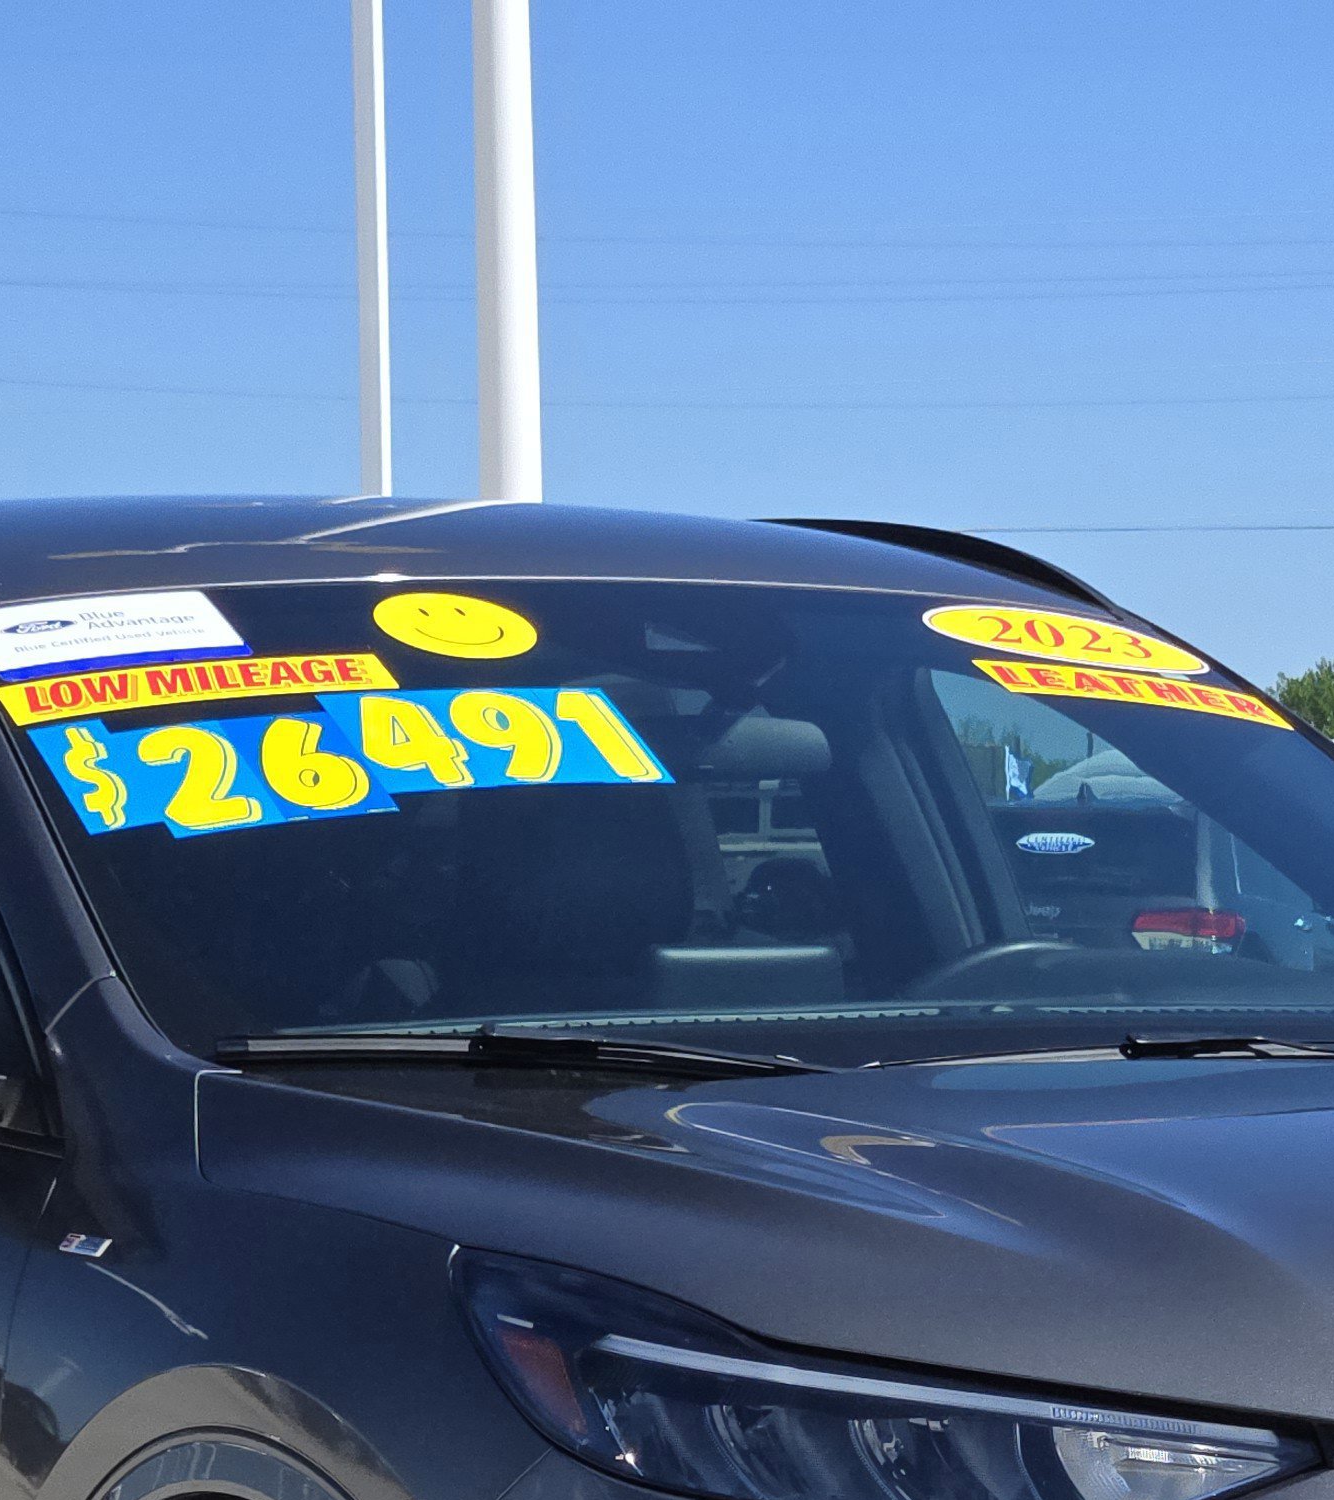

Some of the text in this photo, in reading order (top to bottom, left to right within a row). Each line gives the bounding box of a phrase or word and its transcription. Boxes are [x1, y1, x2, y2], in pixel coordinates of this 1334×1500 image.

[79, 610, 125, 621] Blue
[87, 614, 195, 630] Advantage
[977, 615, 1152, 659] 2023
[24, 658, 369, 713] LOW MILEAGE
[990, 665, 1272, 721] LEATHER
